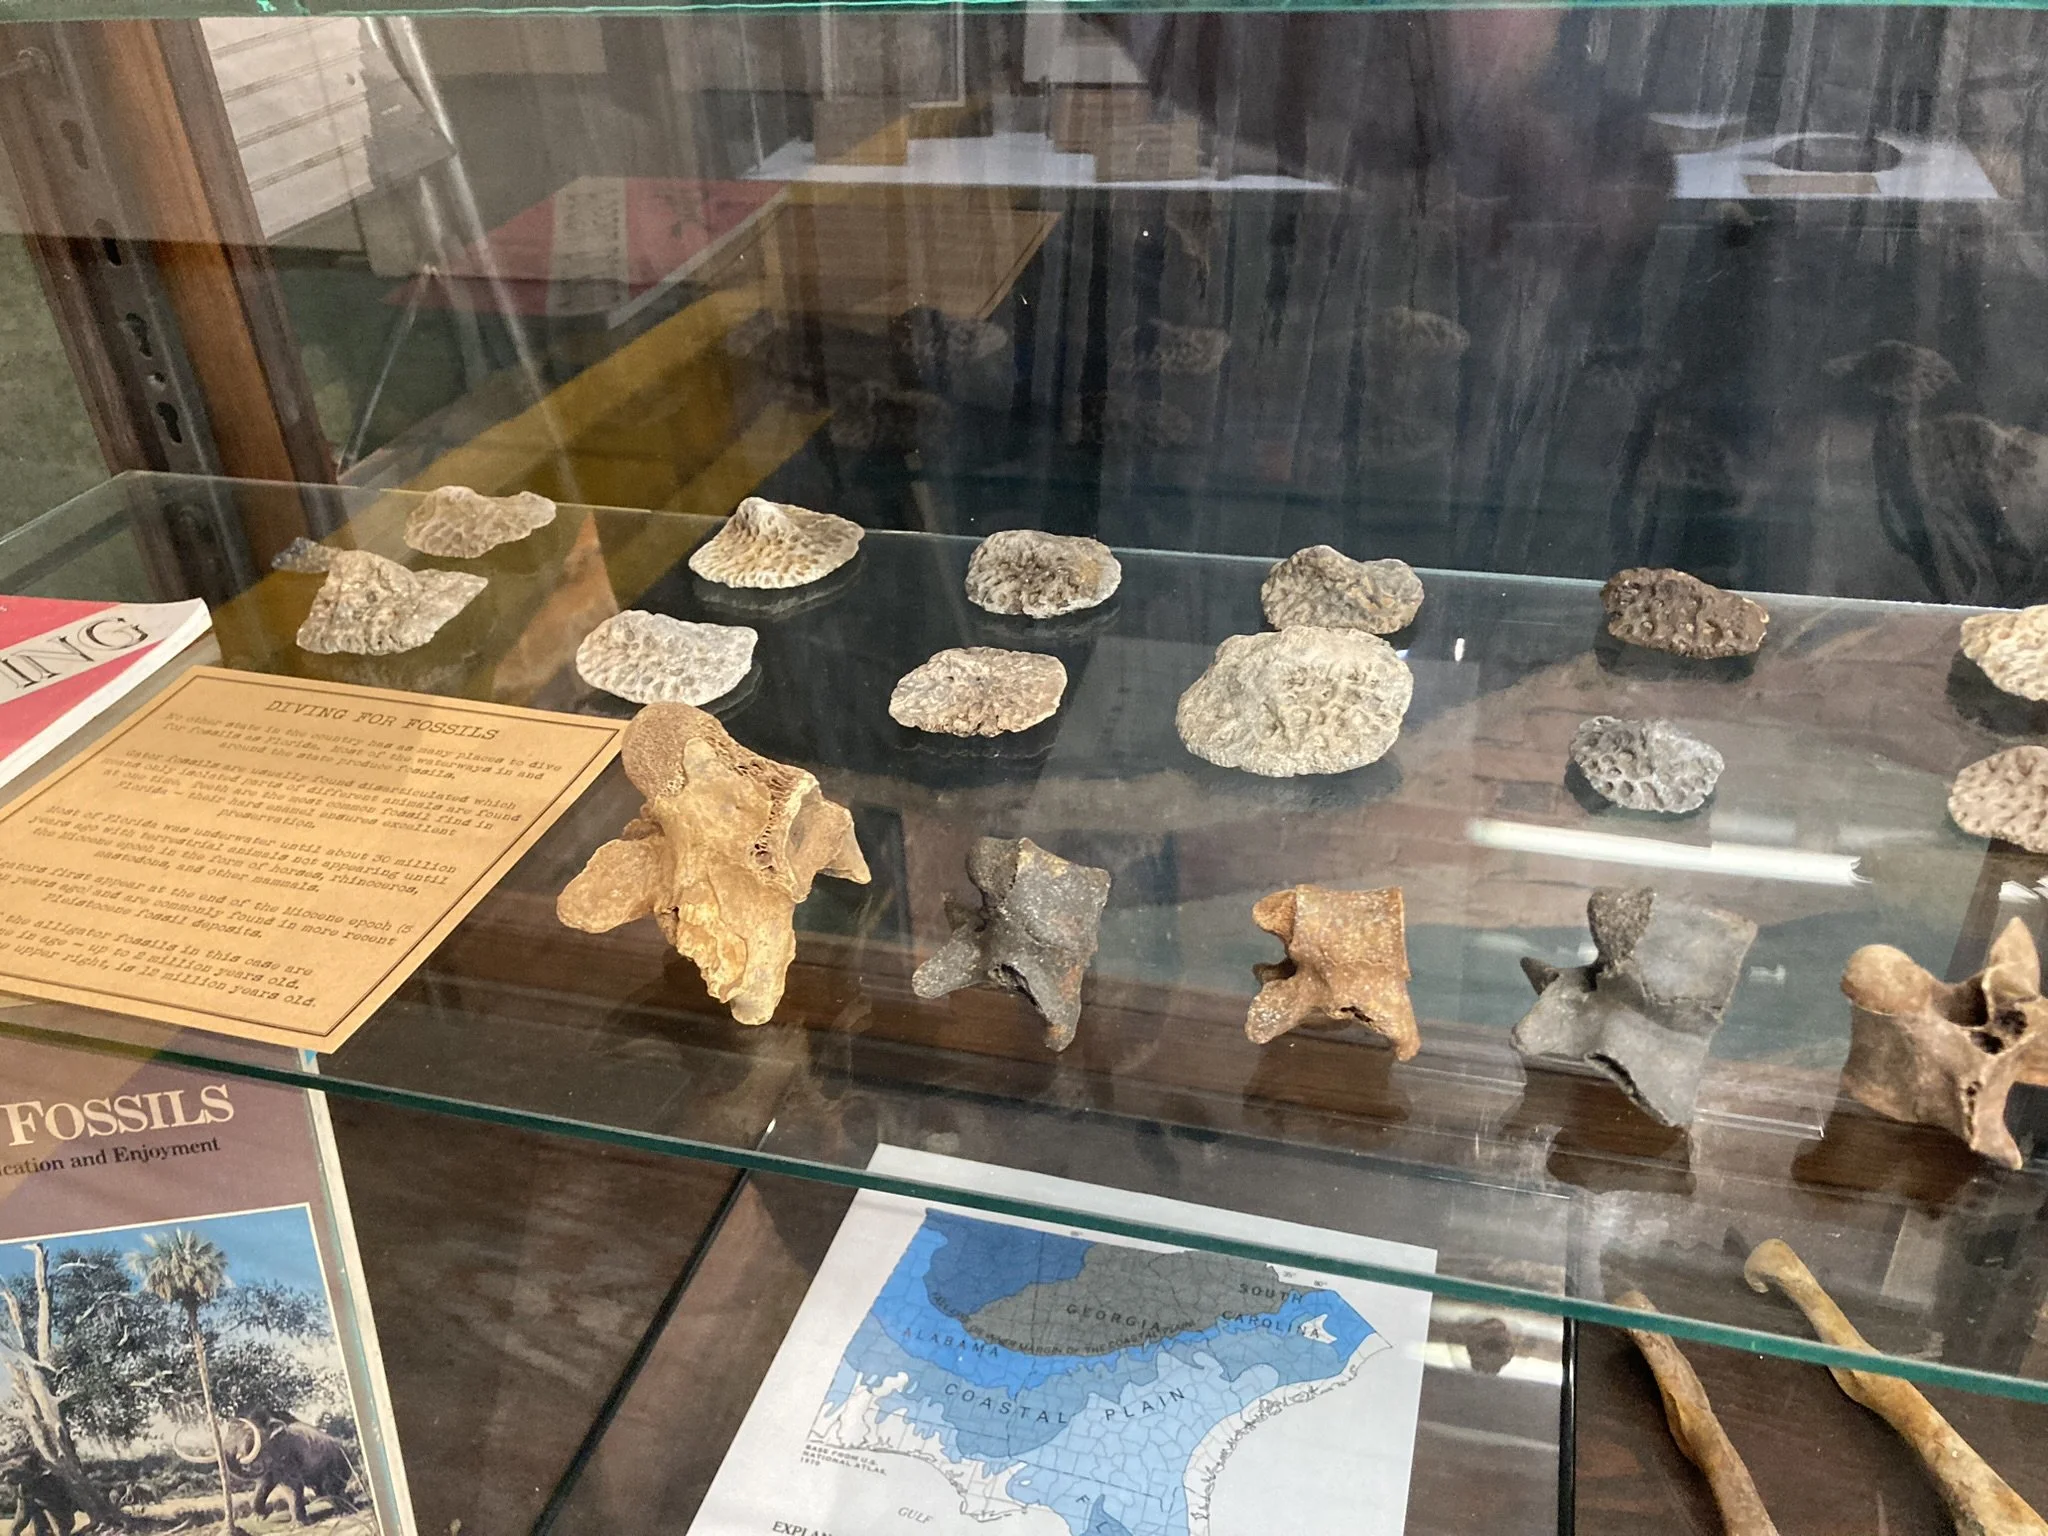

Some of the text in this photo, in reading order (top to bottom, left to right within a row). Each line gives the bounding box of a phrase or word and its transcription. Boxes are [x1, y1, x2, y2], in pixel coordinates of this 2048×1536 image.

[266, 700, 501, 739] DIVING FOR FOSSILS
[188, 726, 242, 738] fossils
[265, 736, 323, 749] Florida.
[329, 745, 365, 754] Most
[388, 753, 413, 761] the
[416, 758, 492, 772] waterways
[496, 767, 513, 775] in
[218, 742, 455, 778] around the state produce fossils.
[225, 722, 262, 730] state
[368, 739, 394, 747] has
[418, 747, 453, 757] many
[454, 752, 505, 762] places
[528, 760, 563, 770] dive
[166, 755, 221, 767] fossils
[251, 768, 309, 781] usually
[312, 775, 356, 786] found
[358, 781, 471, 802] disarticulated
[473, 798, 518, 808] which
[241, 778, 284, 787] parts
[307, 785, 381, 800] different
[383, 797, 443, 809] animals
[447, 806, 473, 814] are
[476, 808, 523, 820] found
[115, 780, 170, 793] Florida
[186, 791, 226, 802] their
[228, 797, 266, 807] hard
[382, 821, 457, 835] excellent
[217, 809, 315, 827] preservation.
[262, 790, 287, 799] the
[290, 796, 325, 804] most
[327, 801, 378, 812] common
[381, 807, 434, 820] fossil
[435, 814, 474, 825] find
[476, 820, 494, 828] in
[28, 816, 72, 826] years
[74, 822, 100, 831] ago
[102, 826, 139, 836] with
[139, 831, 227, 849] terrestrial
[227, 846, 290, 859] animals
[293, 856, 320, 864] not
[322, 860, 400, 878] appearing
[404, 873, 450, 884] until
[32, 827, 57, 836] the
[158, 846, 178, 855] in
[180, 850, 206, 860] the
[209, 854, 245, 866] form
[247, 861, 269, 869] of
[269, 864, 324, 880] horses,
[46, 805, 82, 815] Most
[102, 814, 159, 827] Florida
[162, 824, 191, 832] was
[194, 829, 276, 845] underwater
[279, 841, 324, 852] until
[326, 848, 370, 859] about
[394, 858, 458, 872] million
[50, 867, 93, 880] first
[93, 876, 145, 888] appear
[169, 887, 196, 897] the
[198, 893, 229, 902] end
[229, 898, 251, 906] of
[251, 901, 280, 911] the
[283, 905, 344, 922] Miocene
[347, 918, 394, 930] epoch
[176, 863, 207, 872] and
[207, 868, 249, 879] other
[252, 876, 319, 891] mammals.
[11, 876, 57, 887] years
[92, 889, 124, 898] and
[124, 894, 151, 903] are
[153, 900, 225, 918] commonly
[227, 910, 278, 924] found
[278, 918, 298, 928] in
[301, 924, 340, 935] more
[343, 931, 398, 945] recent
[42, 892, 261, 937] Pleistocene fossil deposits.
[5, 914, 315, 975] the alligator fossils in this case are
[17, 930, 38, 939] in
[39, 936, 68, 946] age
[86, 944, 109, 955] up
[111, 947, 130, 957] to
[132, 951, 147, 959] 2
[147, 955, 212, 972] million
[212, 968, 264, 982] years
[266, 977, 298, 988] old.
[13, 945, 60, 958] upper
[61, 953, 108, 970] right,
[115, 961, 137, 972] is
[139, 966, 161, 976] 12
[161, 972, 228, 989] million
[228, 985, 280, 999] years
[283, 994, 316, 1006] old.
[0, 1084, 234, 1146] FOSSILS
[71, 1149, 107, 1169] and
[113, 1137, 220, 1164] Enjoyment
[1239, 1283, 1303, 1303] SOUTH
[1066, 1303, 1161, 1331] GEORGIA
[1221, 1310, 1320, 1339] CAROLINA
[904, 1328, 998, 1357] ALABAMA
[945, 1383, 1184, 1424] COASTAL PLAIN
[802, 1450, 850, 1467] NATIONAL
[898, 1507, 933, 1524] GULF
